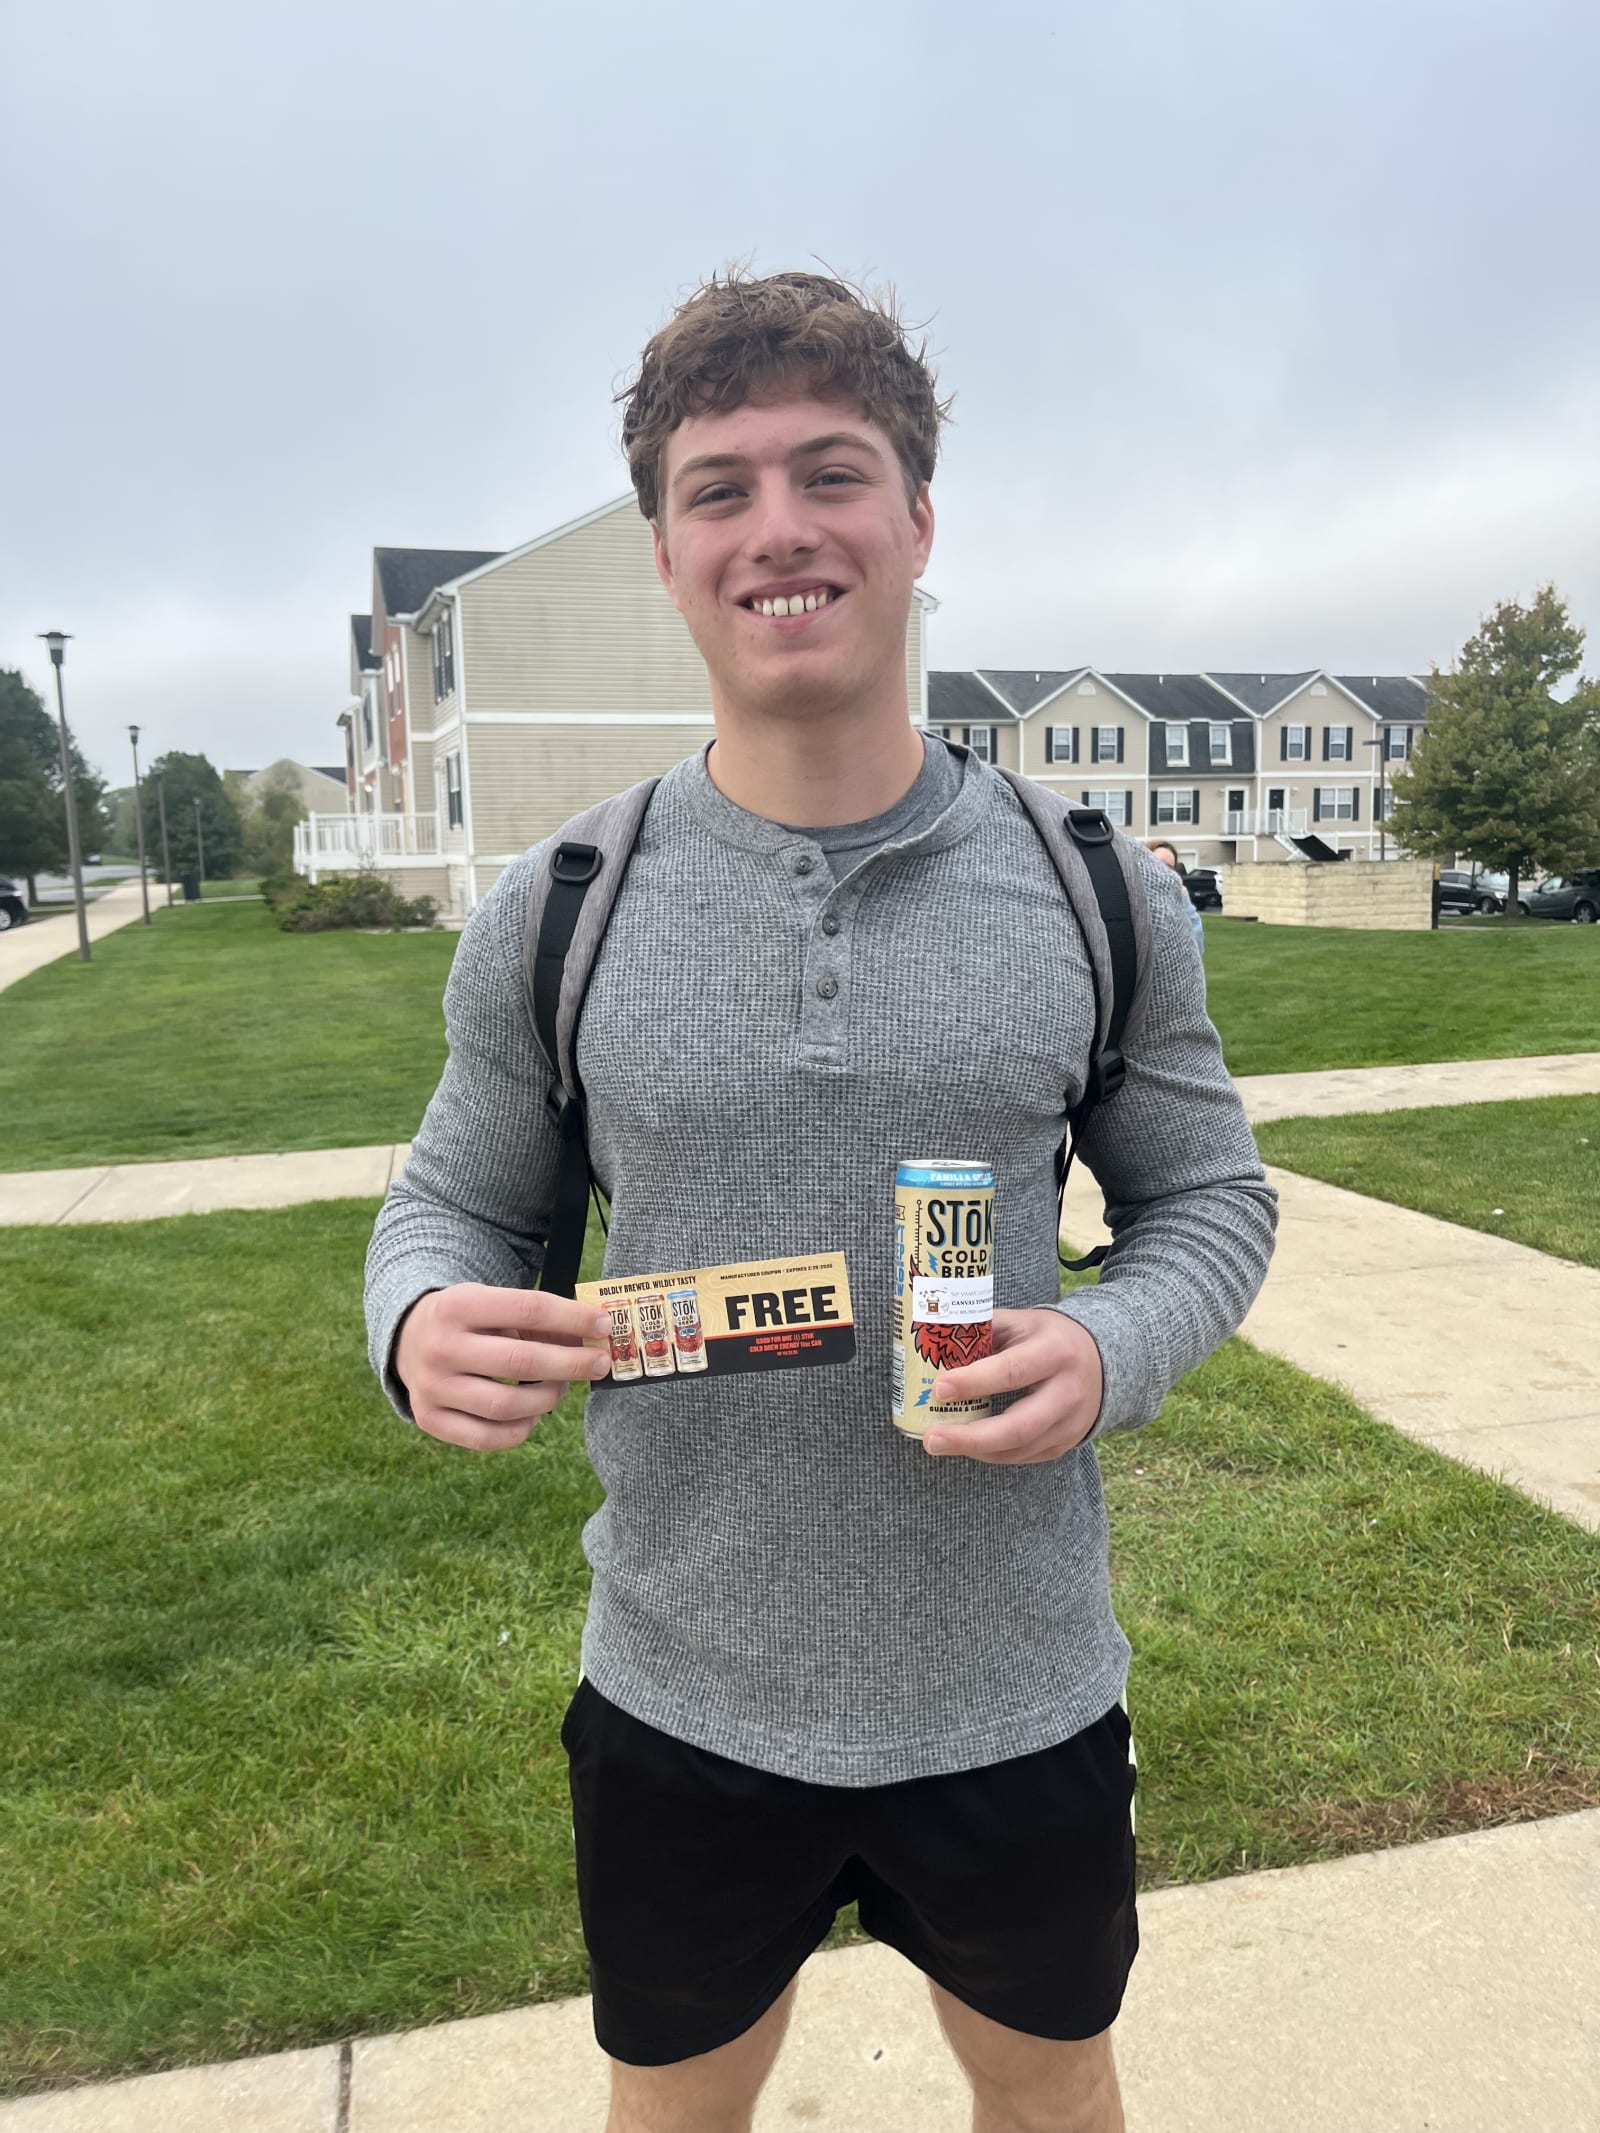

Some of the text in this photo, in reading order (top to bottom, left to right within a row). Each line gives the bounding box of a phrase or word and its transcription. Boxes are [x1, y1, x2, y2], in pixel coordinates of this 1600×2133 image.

[930, 1173, 972, 1182] VANILLA
[941, 1249, 987, 1264] COLD
[720, 1271, 760, 1280] MANUFACTURER
[761, 1269, 782, 1277] COUPON
[786, 1266, 807, 1274] EXPIRES
[941, 1264, 988, 1278] BREW
[599, 1286, 622, 1296] BOLDLY
[652, 1278, 676, 1289] WILDLY
[676, 1276, 696, 1285] TASTY
[725, 1285, 839, 1330] FREE
